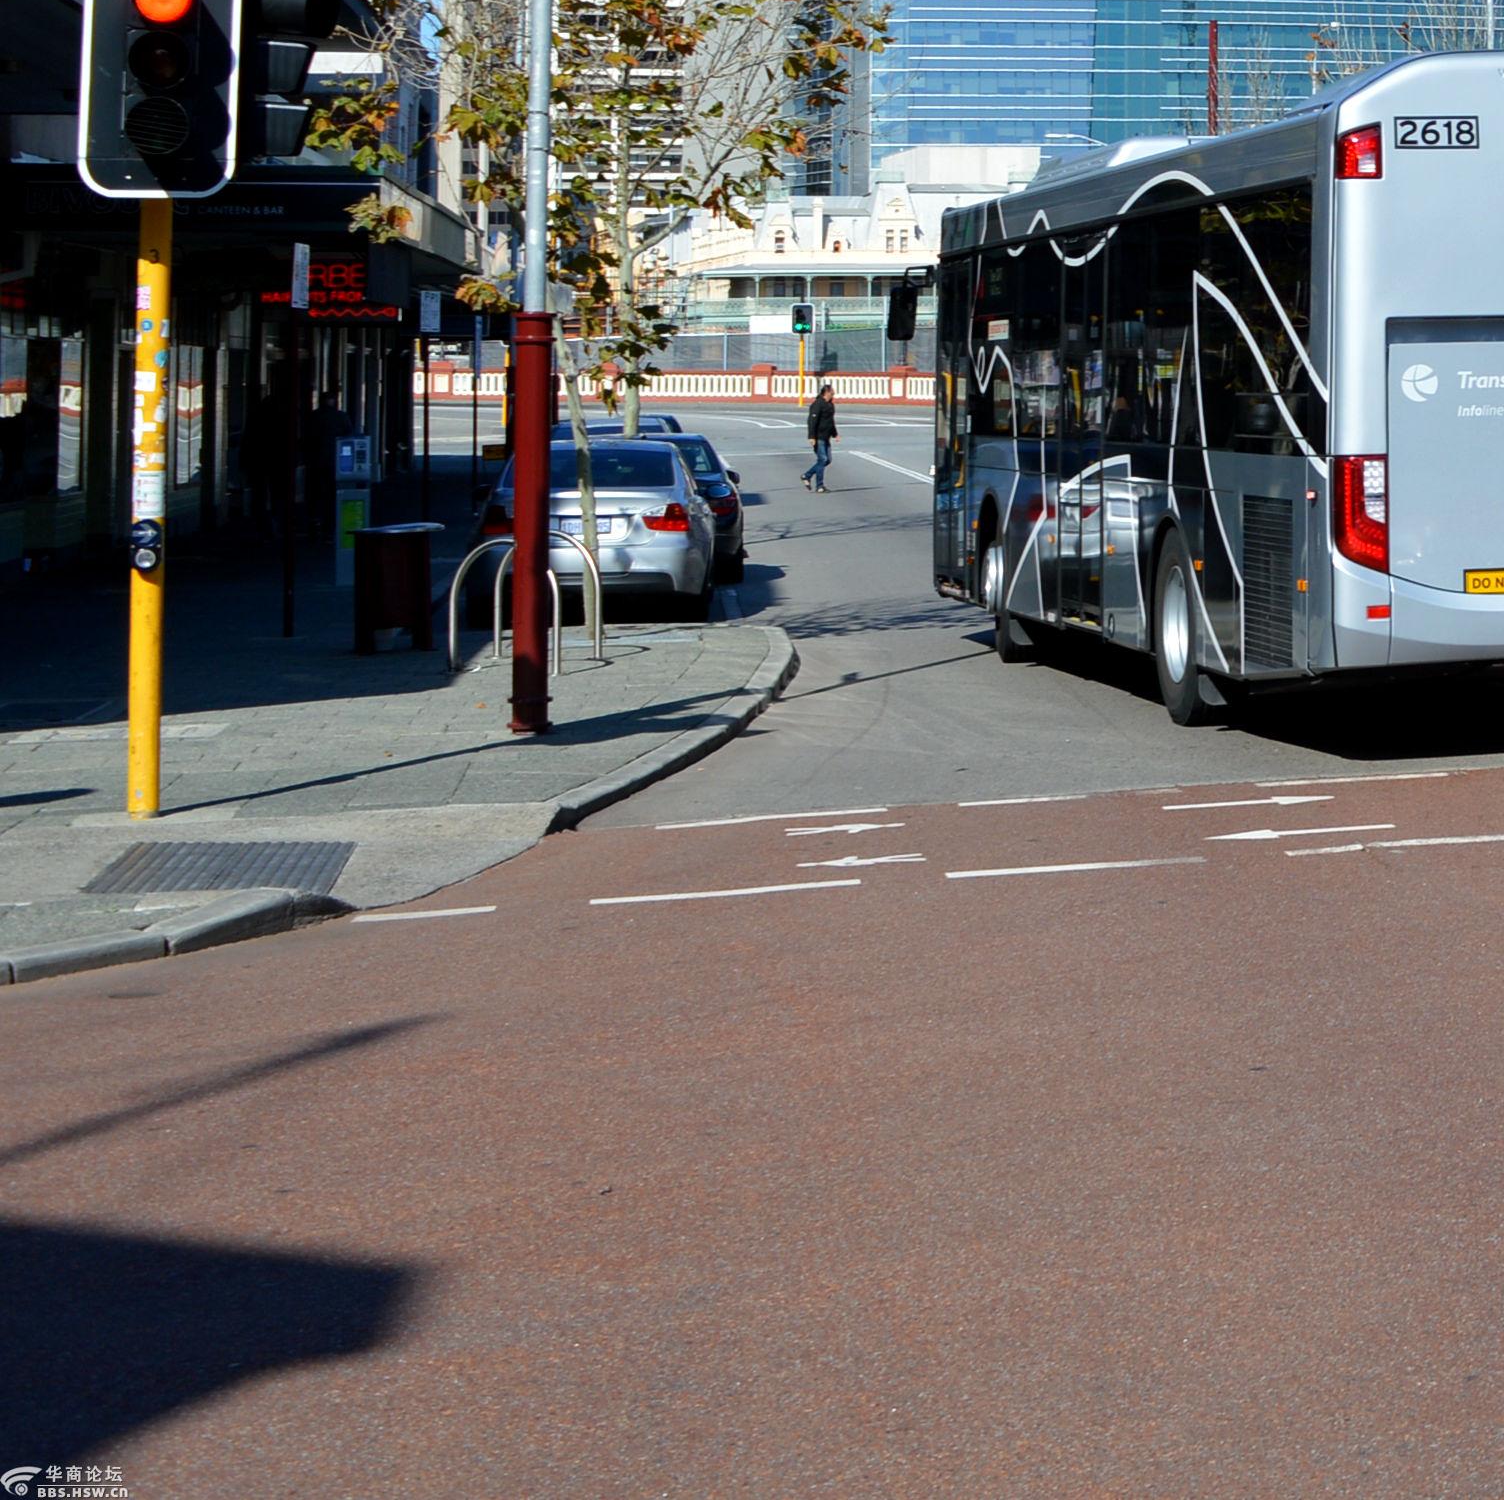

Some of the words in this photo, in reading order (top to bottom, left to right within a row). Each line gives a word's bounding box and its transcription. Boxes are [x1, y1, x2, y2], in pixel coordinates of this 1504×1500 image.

[1399, 120, 1476, 146] 2618
[1457, 404, 1504, 417] Infoline
[1472, 578, 1491, 589] DO
